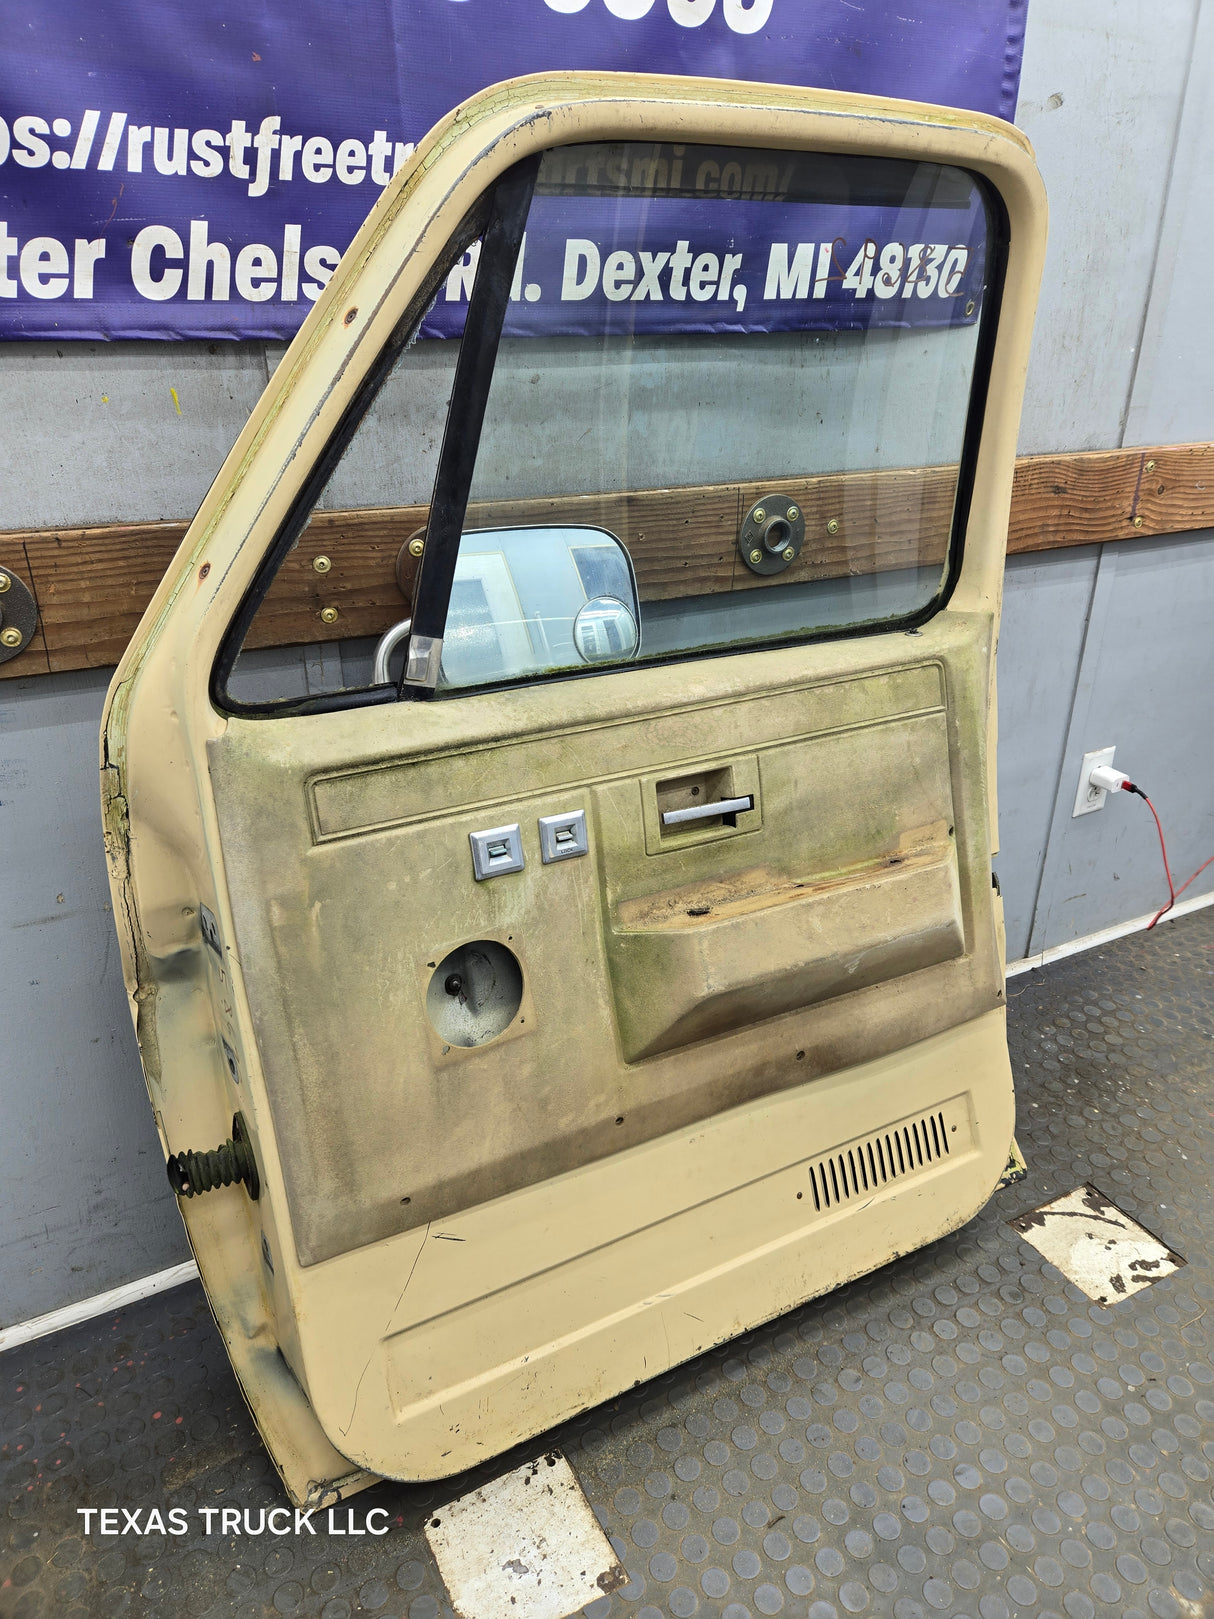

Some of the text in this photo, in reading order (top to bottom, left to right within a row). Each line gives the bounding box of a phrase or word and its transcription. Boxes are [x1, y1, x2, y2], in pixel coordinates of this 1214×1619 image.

[561, 238, 747, 312] Dexter,
[763, 243, 831, 299] MI
[842, 243, 969, 299] 48130
